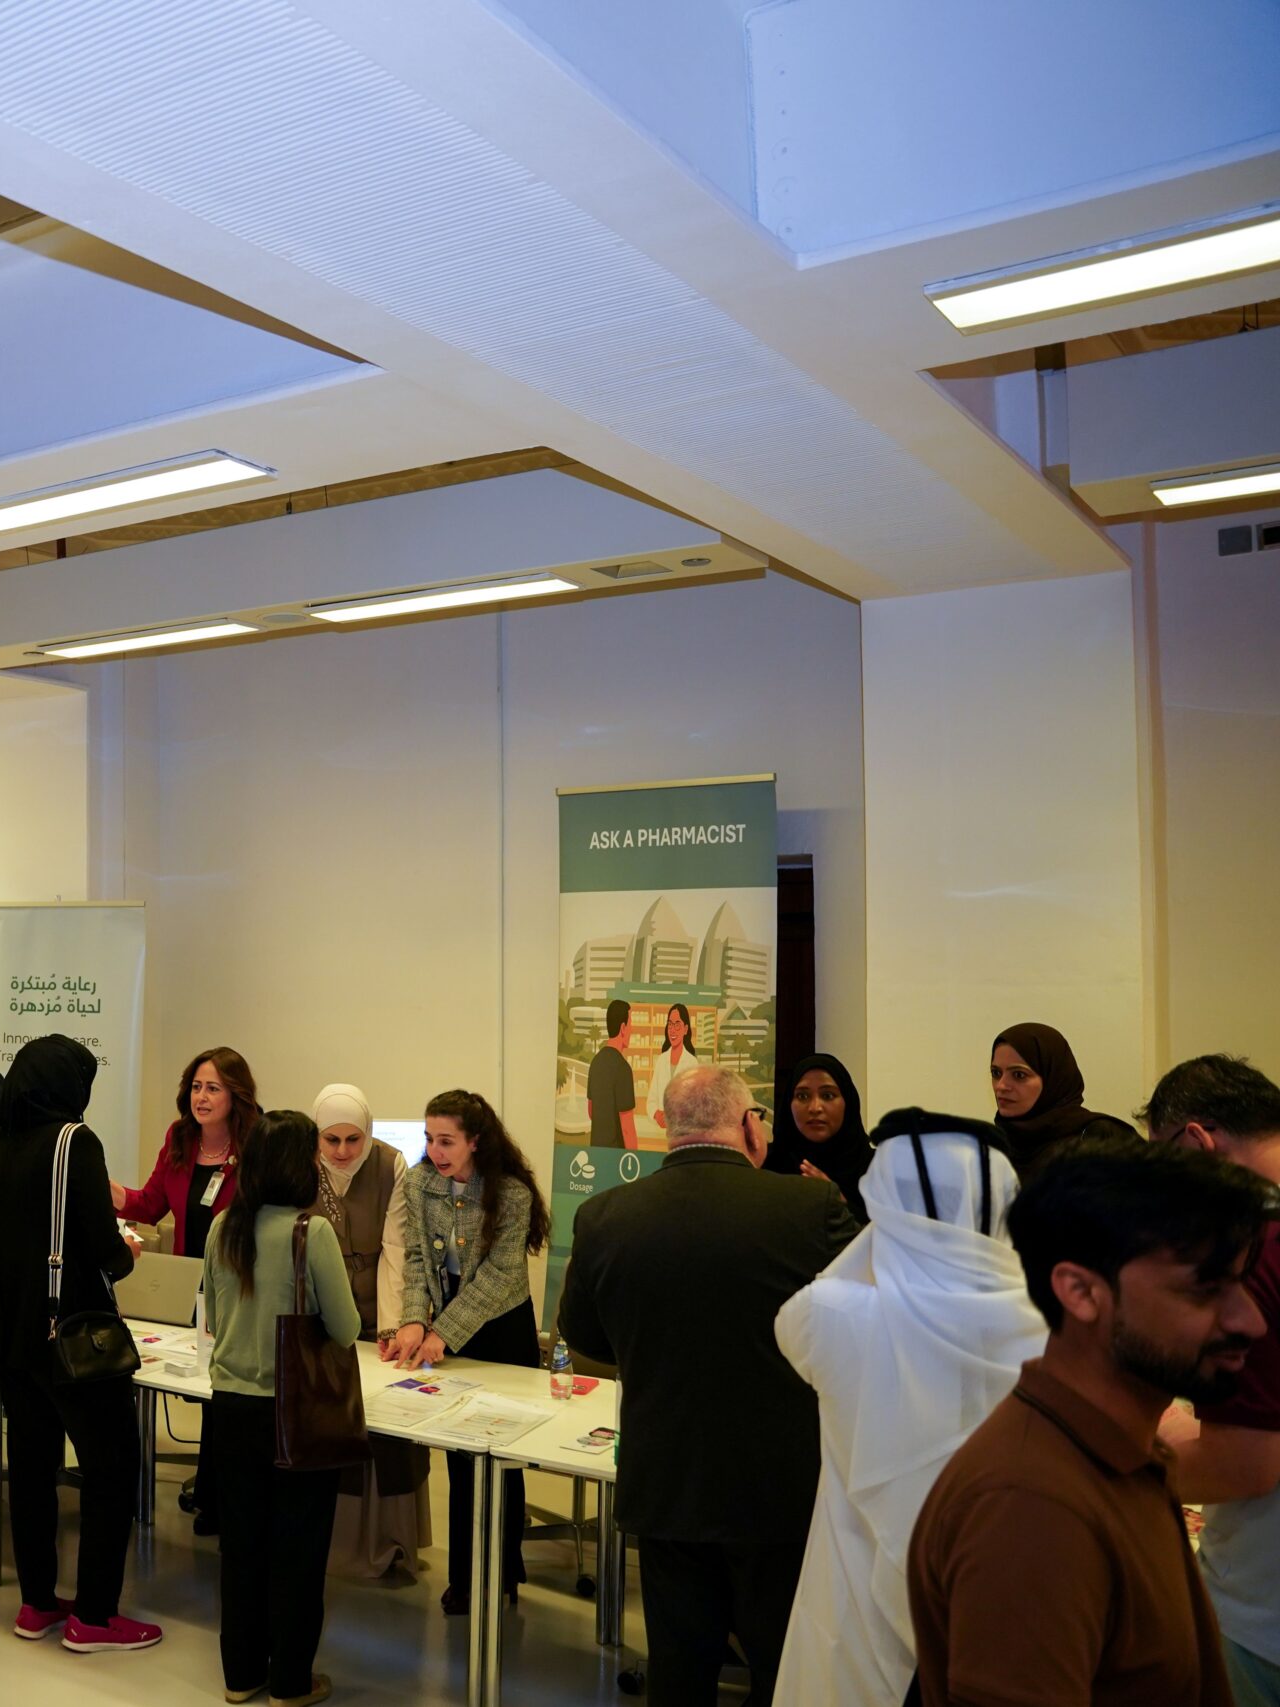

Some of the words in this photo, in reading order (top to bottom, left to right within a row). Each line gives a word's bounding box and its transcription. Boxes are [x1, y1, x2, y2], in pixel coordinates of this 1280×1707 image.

[589, 829, 620, 850] ASK
[623, 829, 634, 848] A
[638, 823, 746, 847] PHARMACIST
[10, 973, 57, 995] مُبتكرة
[62, 976, 97, 995] رعاية
[67, 998, 101, 1018] لحياة
[569, 1181, 594, 1194] Dosage
